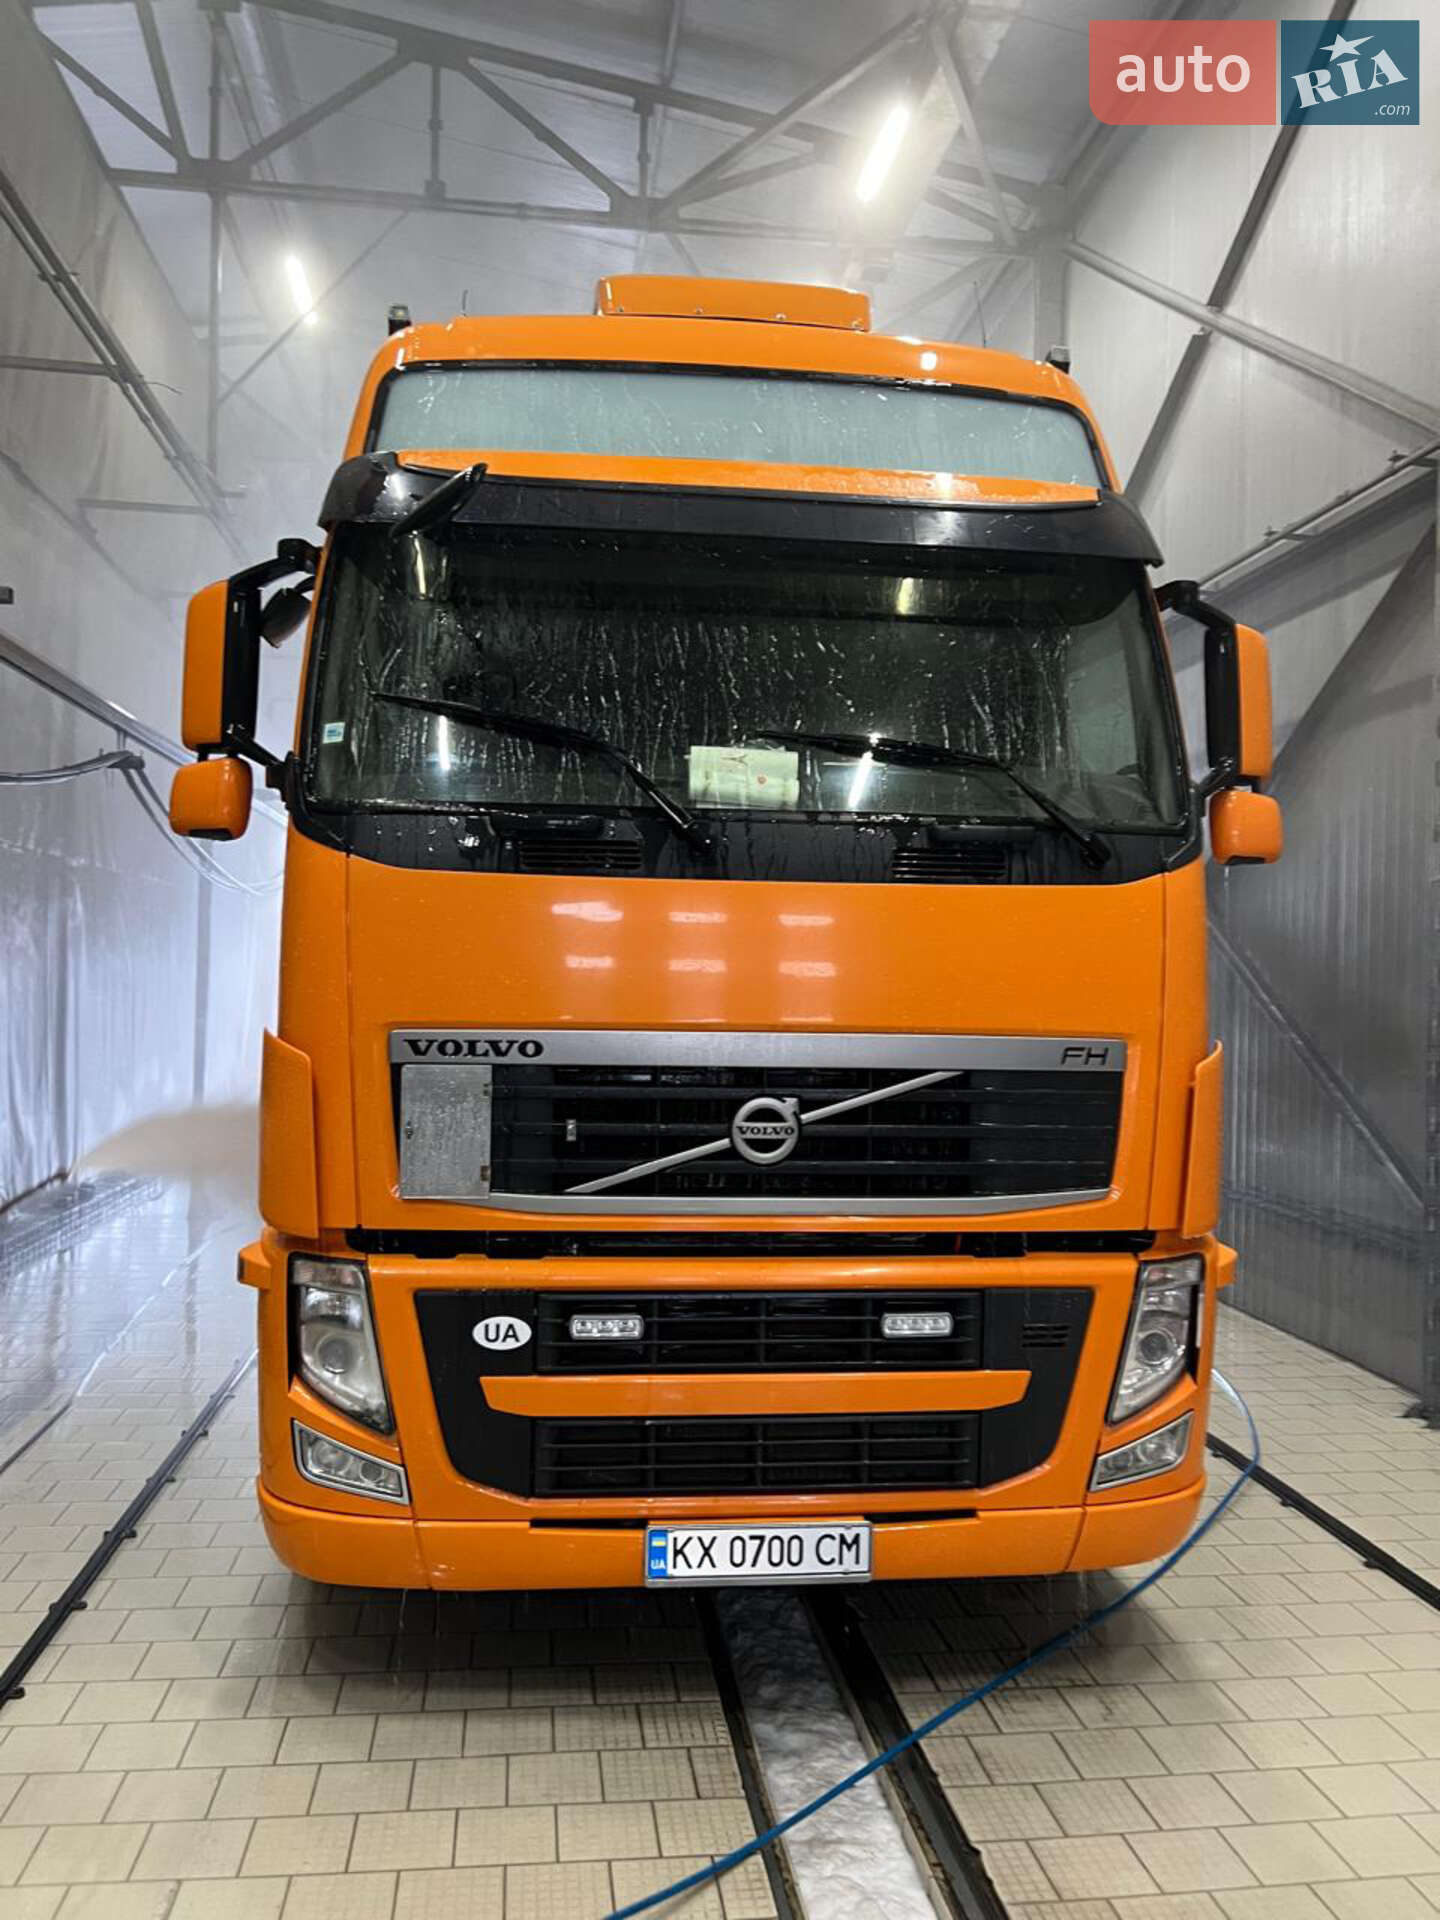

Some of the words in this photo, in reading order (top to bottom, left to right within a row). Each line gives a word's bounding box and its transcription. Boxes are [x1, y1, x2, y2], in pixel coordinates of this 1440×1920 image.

[403, 1039, 544, 1058] VOLVO
[1061, 1046, 1109, 1066] FH
[736, 1126, 795, 1136] VOLVO
[484, 1323, 519, 1343] UA
[672, 1536, 717, 1569] KX
[729, 1535, 804, 1567] 0700
[815, 1533, 860, 1566] CM
[651, 1559, 665, 1569] UA
